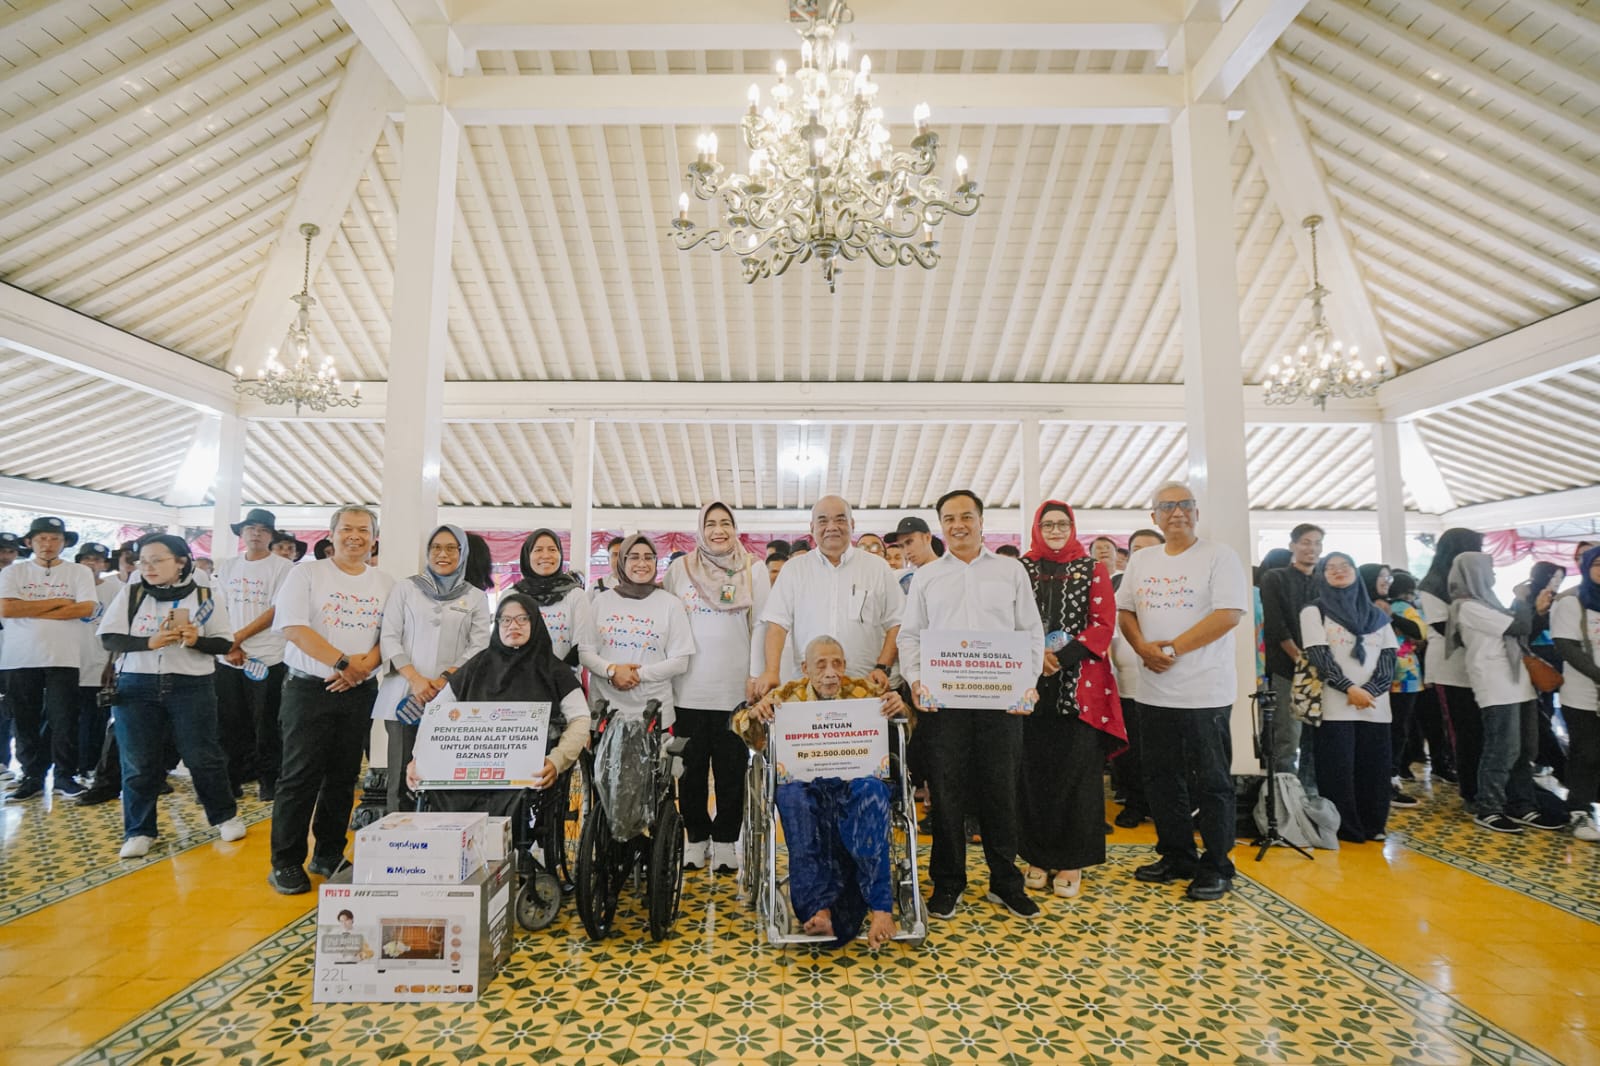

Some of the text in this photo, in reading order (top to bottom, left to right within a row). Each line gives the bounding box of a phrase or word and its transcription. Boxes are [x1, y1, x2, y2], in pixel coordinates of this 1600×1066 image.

[982, 652, 1013, 660] SOSIAL
[930, 659, 1023, 669] DINAS SOSIAL DIY
[942, 683, 952, 691] Rp
[495, 725, 538, 733] BANTUAN
[785, 729, 880, 740] BBPPKS YOGYAKARTA
[798, 751, 809, 759] Rp
[389, 839, 421, 850] Miyako
[395, 866, 426, 876] Miyako
[321, 968, 349, 982] 22L
